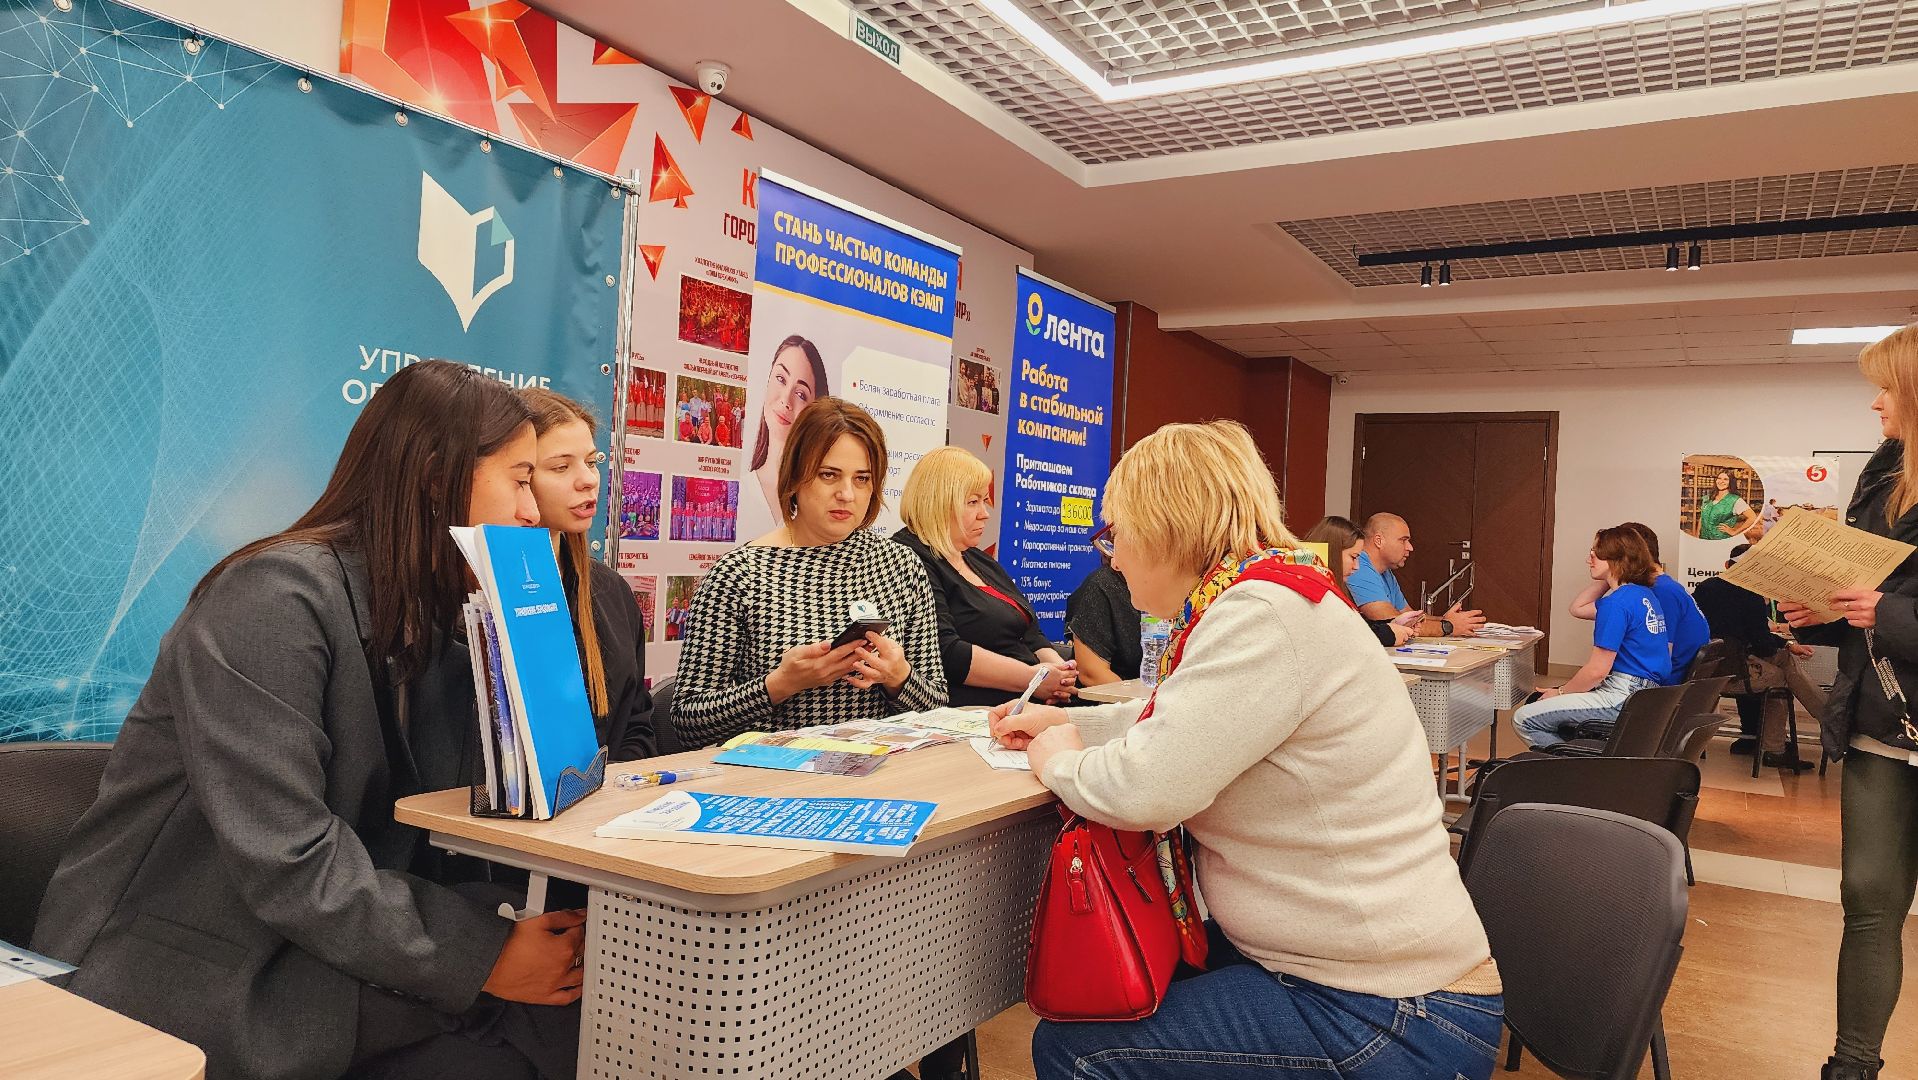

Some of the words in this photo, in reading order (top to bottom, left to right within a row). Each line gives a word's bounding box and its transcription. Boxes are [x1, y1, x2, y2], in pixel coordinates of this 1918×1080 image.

[857, 21, 898, 63] ВЫХОД
[723, 212, 757, 249] ГОРО
[773, 210, 823, 245] СТАНЬ
[825, 228, 882, 266] ЧАСТЬЮ
[884, 250, 948, 289] КОМАНДЫ
[775, 241, 909, 303] ПРОФЕССИОНАЛОВ
[910, 287, 944, 314] КЭМП
[954, 300, 971, 322] ИР»
[1044, 313, 1105, 359] лента
[1021, 358, 1069, 393] Работа
[1019, 392, 1028, 408] в
[1030, 393, 1104, 426] стабильной
[1017, 418, 1088, 447] компании!
[1016, 452, 1073, 476] Приглашаем
[1015, 472, 1068, 494] Работников
[1068, 484, 1097, 498] склада
[1022, 538, 1067, 553] Корпоративный
[1033, 575, 1052, 590] бонус
[1687, 567, 1722, 578] Цени
